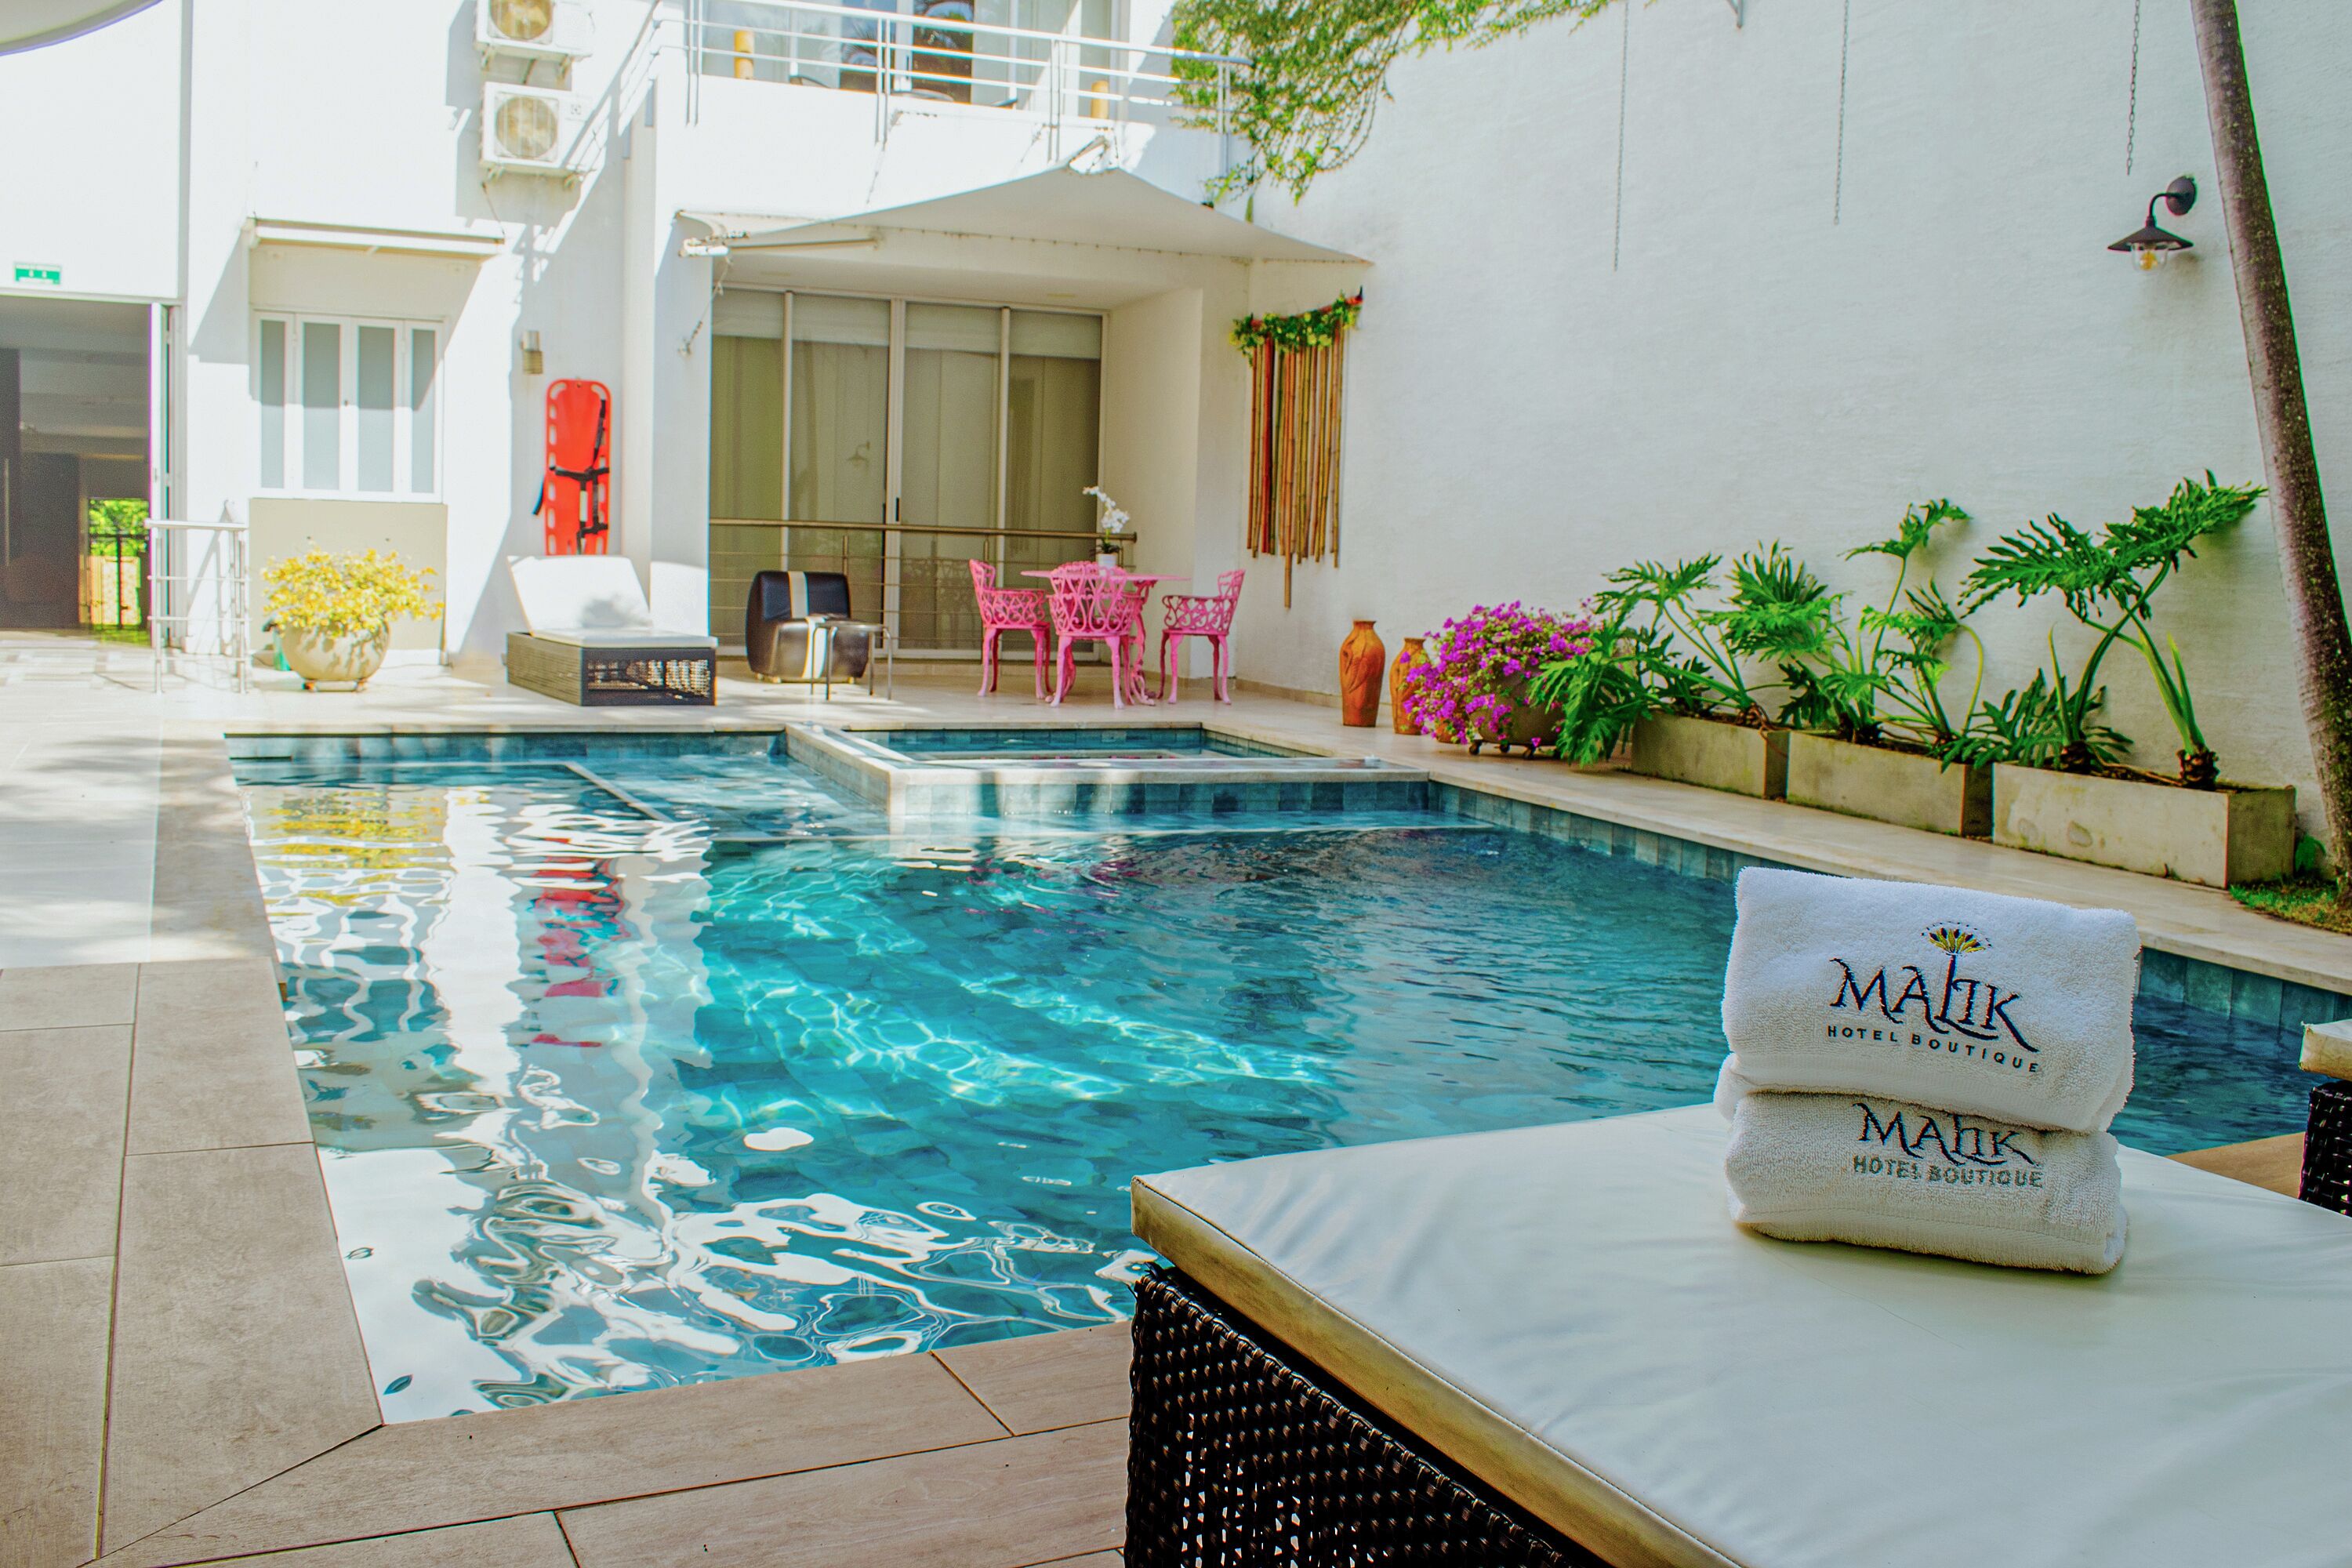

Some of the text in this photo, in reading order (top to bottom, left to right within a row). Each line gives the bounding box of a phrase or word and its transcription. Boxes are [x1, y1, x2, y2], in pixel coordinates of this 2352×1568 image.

[1829, 954, 2040, 1053] MALIK
[1828, 1025, 2039, 1073] HOTEL BOUTIQUE
[1852, 1102, 2039, 1167] MALIK
[1853, 1155, 2044, 1188] HOTEL BOUTIQUE
